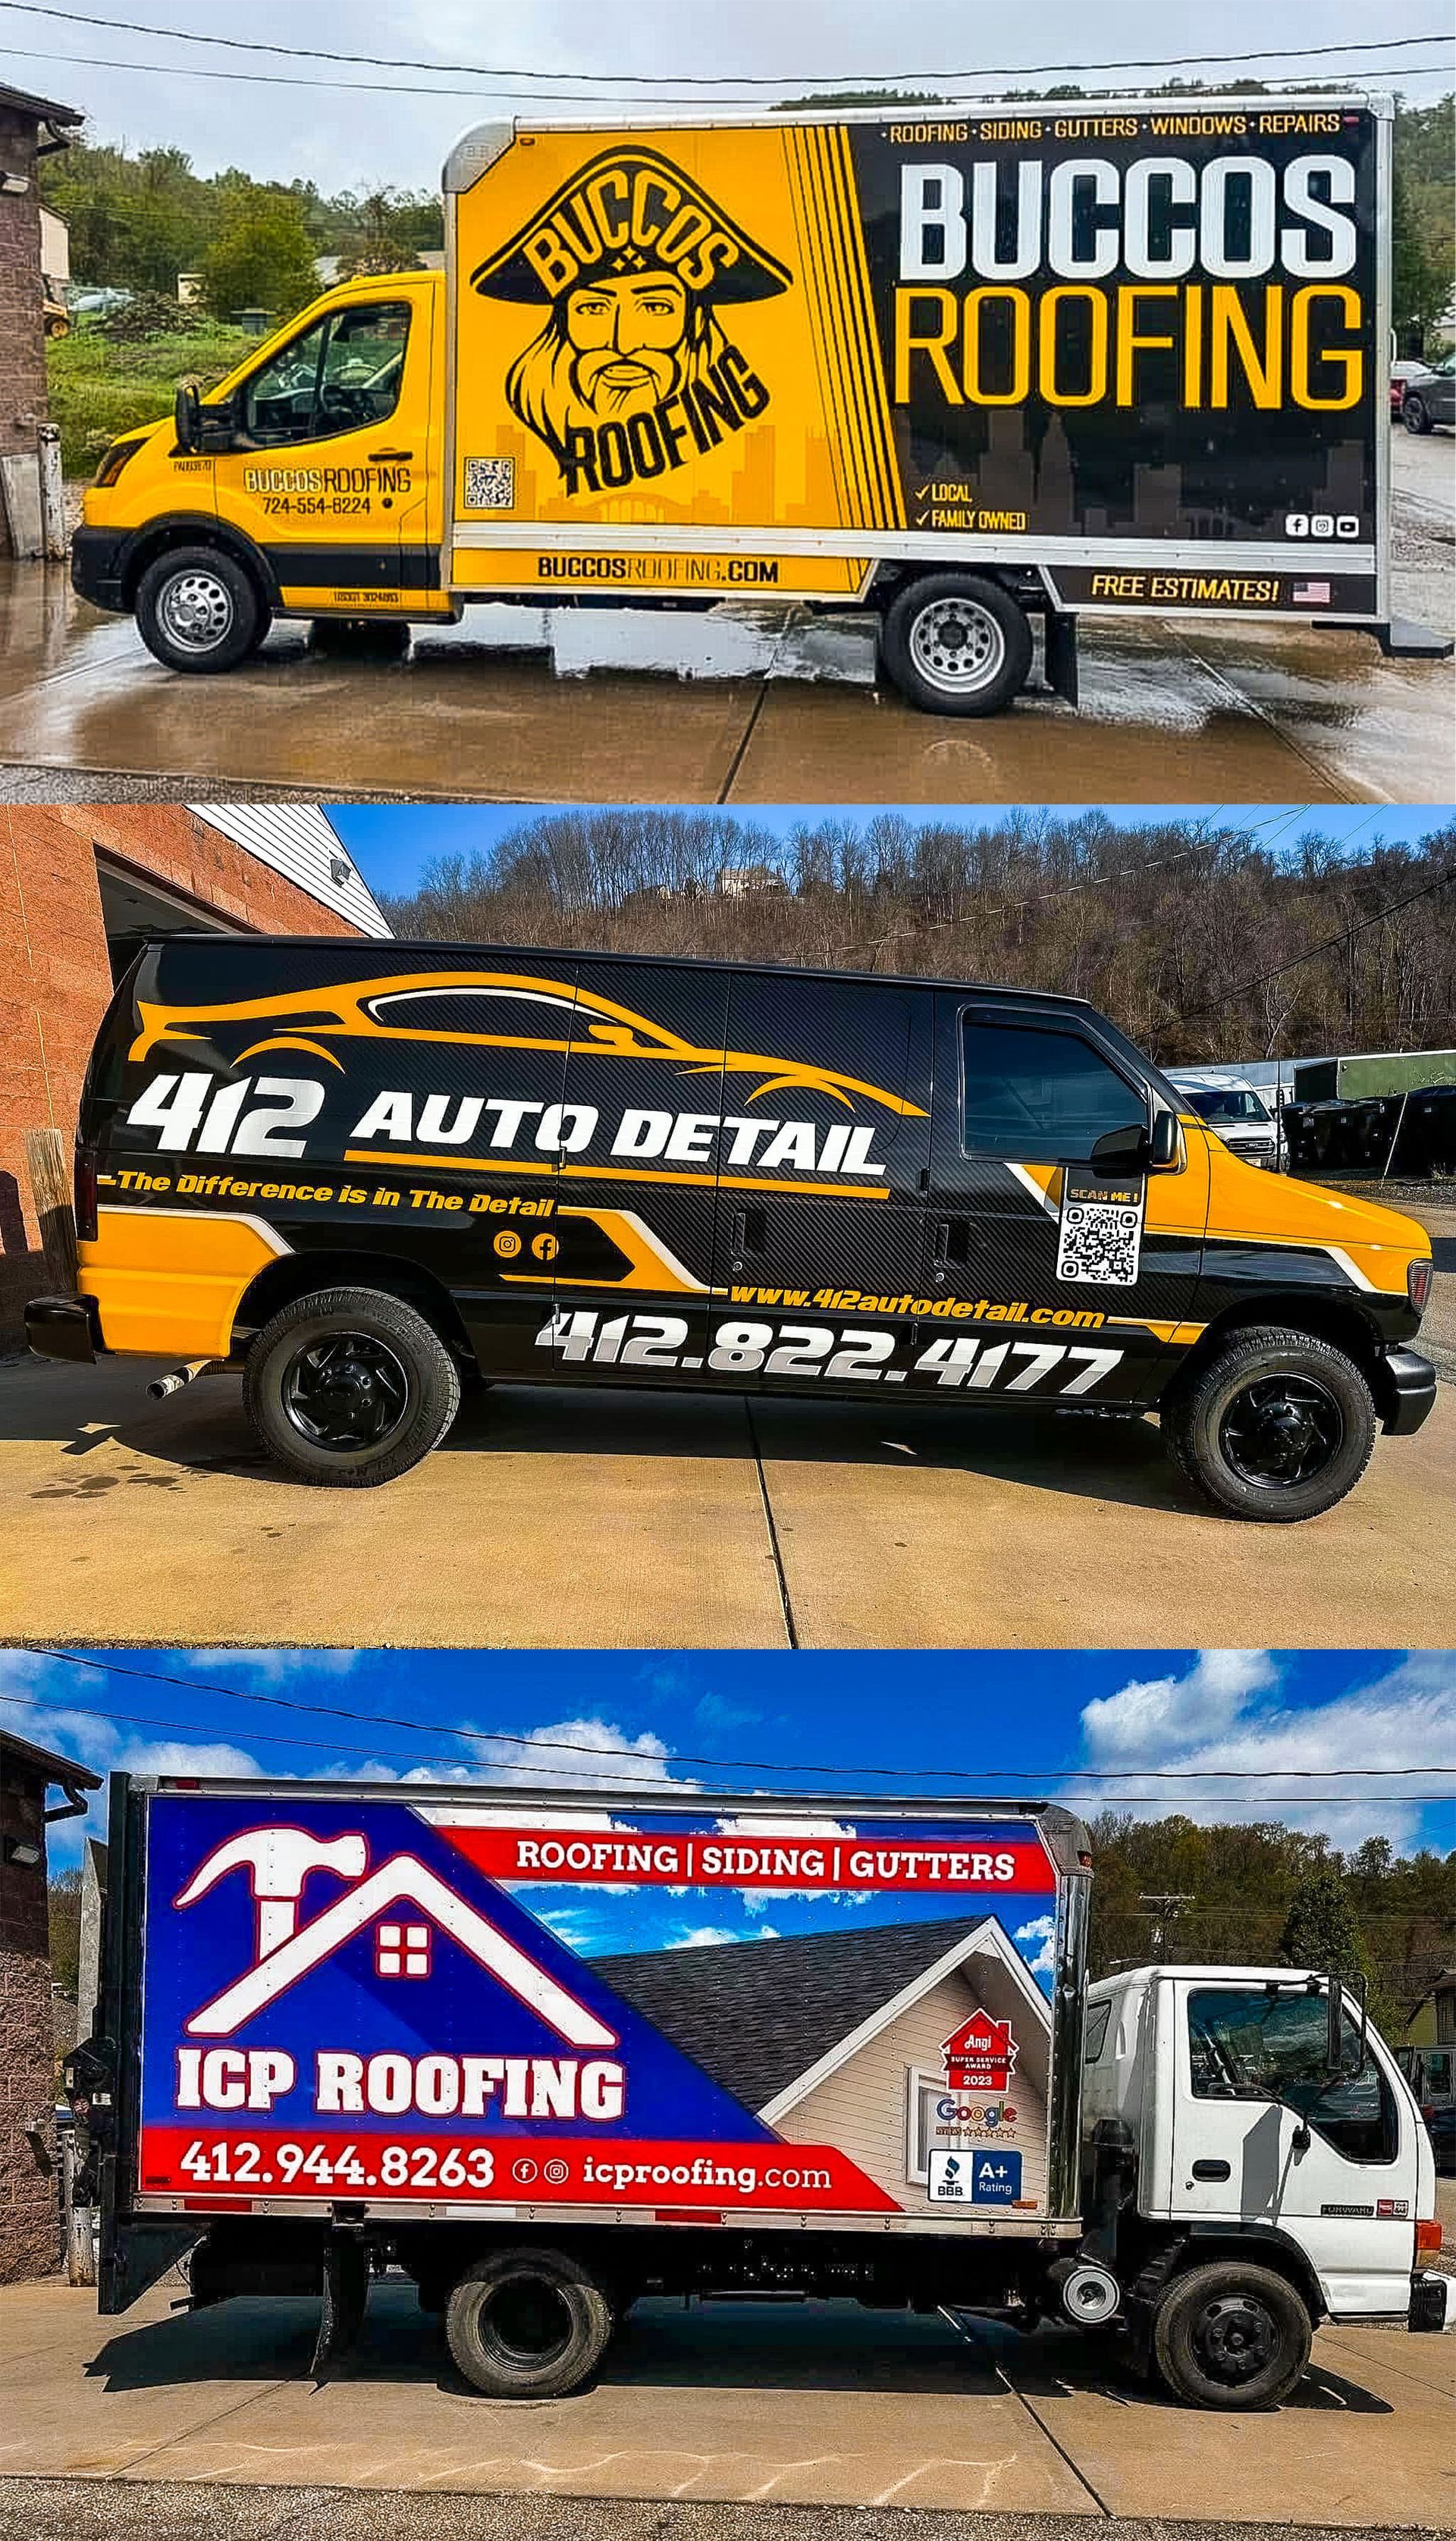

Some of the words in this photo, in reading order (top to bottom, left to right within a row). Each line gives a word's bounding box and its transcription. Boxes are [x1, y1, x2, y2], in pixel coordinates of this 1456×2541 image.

[890, 124, 968, 143] ROOFING
[980, 121, 1043, 140] SIDING
[1054, 118, 1138, 138] GUTTERS
[1150, 116, 1247, 134] WINDOWS
[1259, 114, 1341, 133] REPAIRS
[899, 155, 1357, 281] BUCCOS
[523, 168, 740, 299] BUCCOS
[894, 284, 1363, 410] ROOFING
[564, 344, 772, 498] ROOFING
[931, 483, 972, 503] LOCAL
[931, 509, 975, 528] FAMILY
[978, 511, 1026, 530] OWNED
[538, 557, 779, 583] BUCCOSROOFING.COM
[1091, 574, 1145, 597] FREE
[1150, 577, 1279, 601] ESTIMATES!
[126, 1072, 326, 1159] 412
[348, 1090, 600, 1154] AUTO
[610, 1107, 887, 1176] DETAIL
[118, 1170, 171, 1192] The
[175, 1173, 333, 1202] Difference
[337, 1185, 369, 1204] is
[372, 1187, 400, 1207] in
[409, 1189, 465, 1211] The
[468, 1194, 556, 1217] Detail
[1070, 1189, 1108, 1200] SCAN
[730, 1286, 1105, 1329] www.412autodetail.com
[535, 1311, 1125, 1395] 412.822.4177
[516, 1840, 679, 1873] ROOFING
[701, 1847, 825, 1877] SIDING
[849, 1851, 1015, 1881] GUTTERS
[964, 2034, 992, 2051] Angi
[177, 2047, 297, 2111] ICP
[315, 2051, 626, 2120] ROOFING
[963, 2075, 993, 2086] 2023
[937, 2098, 1018, 2128] Google
[180, 2141, 495, 2188] 412.944.8263
[583, 2156, 833, 2192] icproofing.com
[979, 2163, 1008, 2178] A+
[938, 2186, 963, 2196] BBB
[979, 2181, 1012, 2195] Rating
